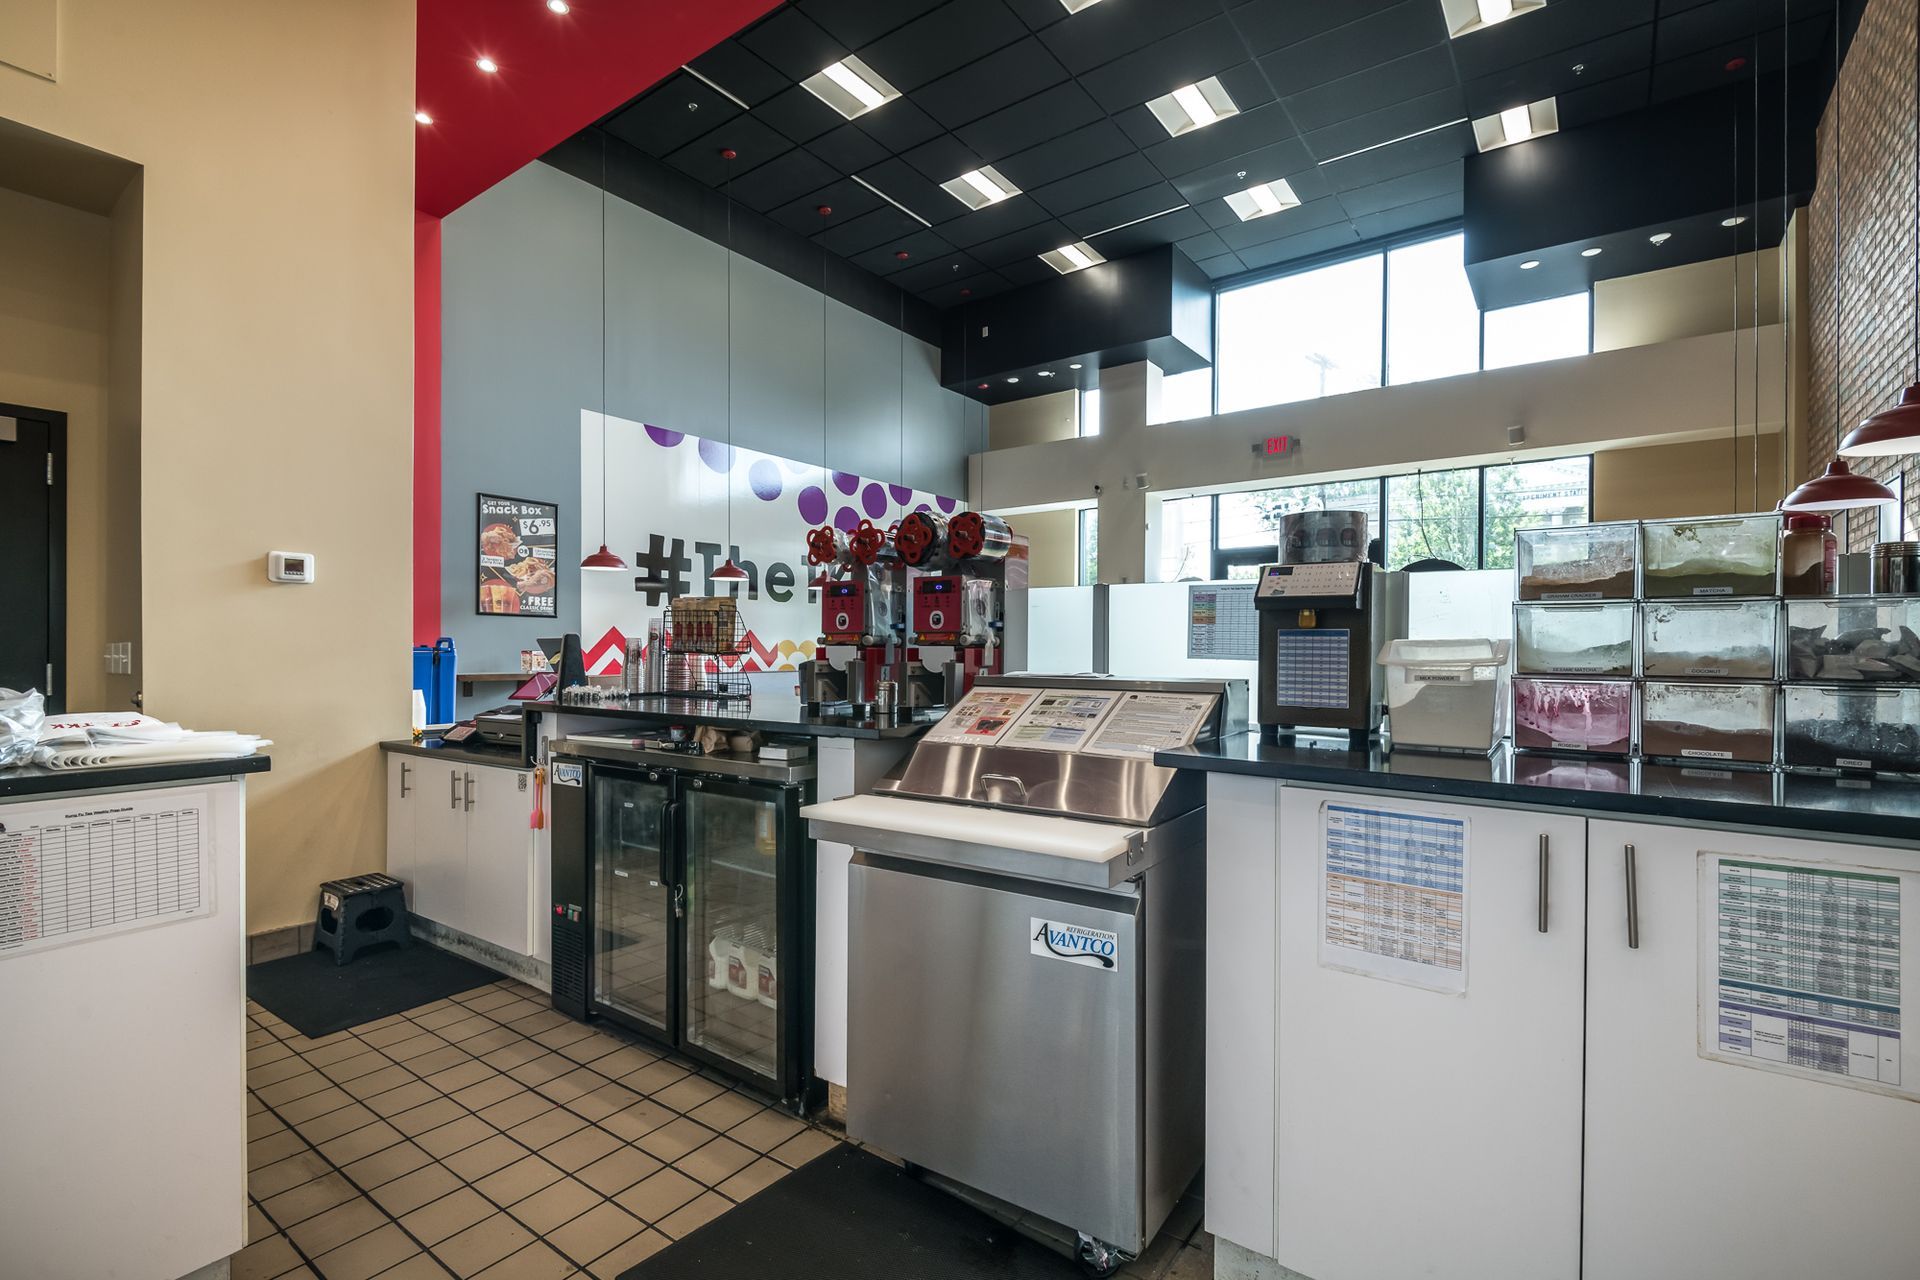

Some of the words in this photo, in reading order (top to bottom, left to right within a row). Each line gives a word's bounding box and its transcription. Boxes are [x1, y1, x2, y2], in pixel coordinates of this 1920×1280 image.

[1267, 435, 1288, 455] EXIT
[482, 504, 519, 514] Snack
[521, 505, 542, 515] Box
[528, 596, 554, 606] FREE
[1033, 922, 1115, 960] AVANTCO
[1066, 926, 1115, 941] REFRIGERATION
